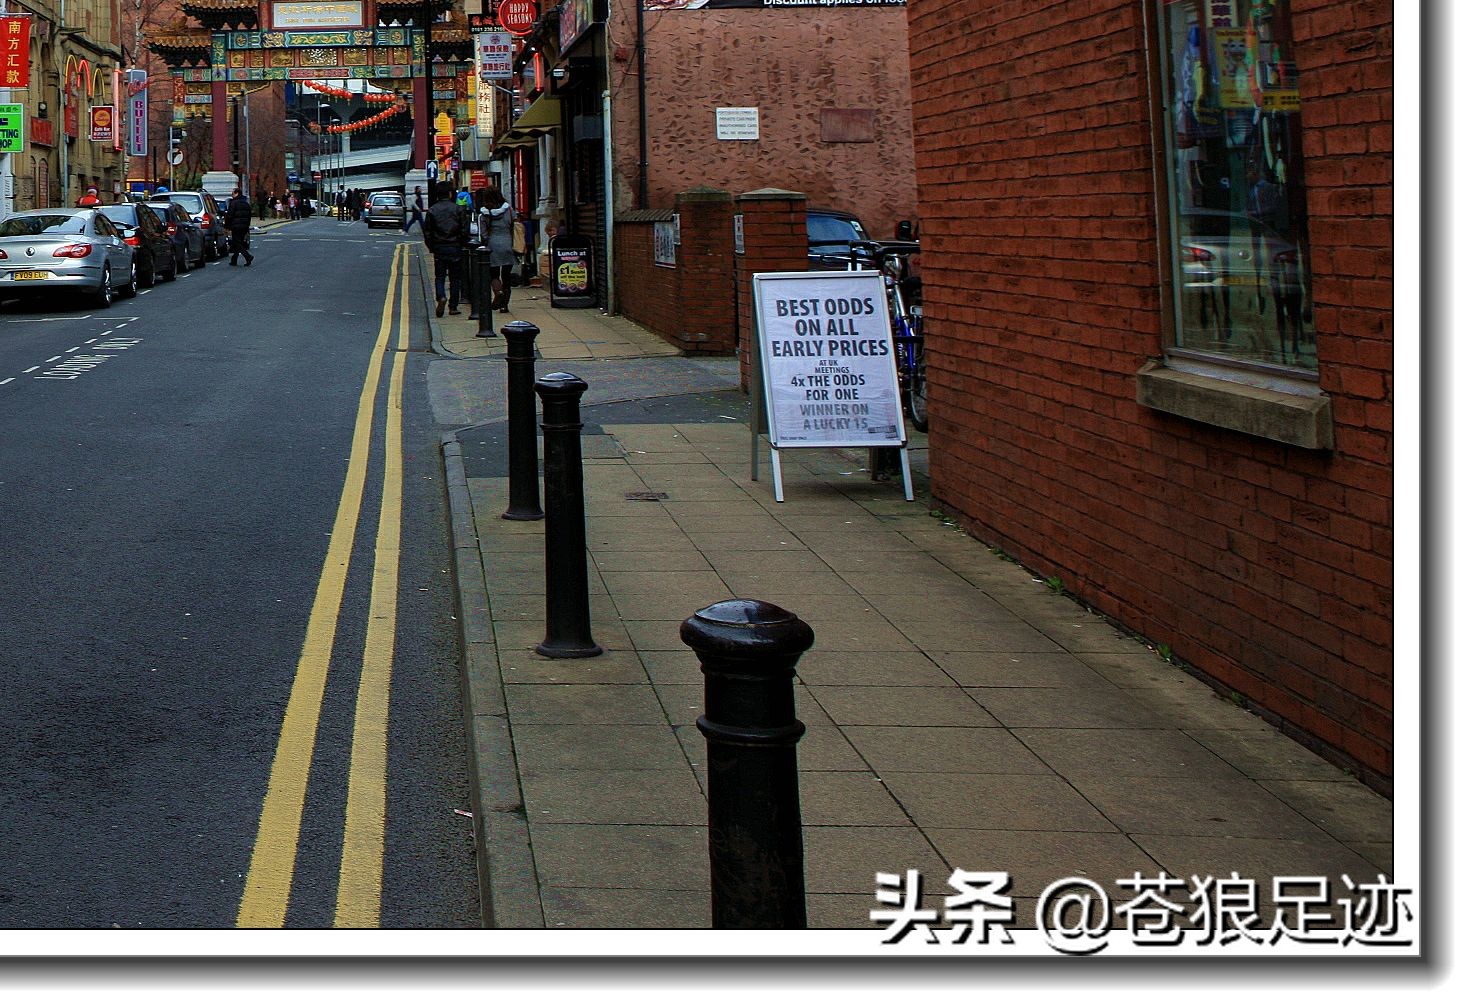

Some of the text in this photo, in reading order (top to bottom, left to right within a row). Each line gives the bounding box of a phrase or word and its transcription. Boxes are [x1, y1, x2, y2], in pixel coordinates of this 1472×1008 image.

[509, 3, 529, 13] HAPPY
[507, 12, 533, 25] SEASONS
[6, 21, 22, 84] 南方汇款
[134, 100, 143, 152] BUFFET
[560, 265, 570, 274] £1
[776, 297, 875, 317] BEST ODDS
[795, 318, 859, 336] ON ALL
[771, 339, 889, 357] EARLY PRICES
[790, 374, 866, 387] 4x THE ODDS
[806, 388, 859, 401] FOR ONE
[799, 403, 869, 416] WINNER ON
[803, 418, 868, 430] A LUCKY 15
